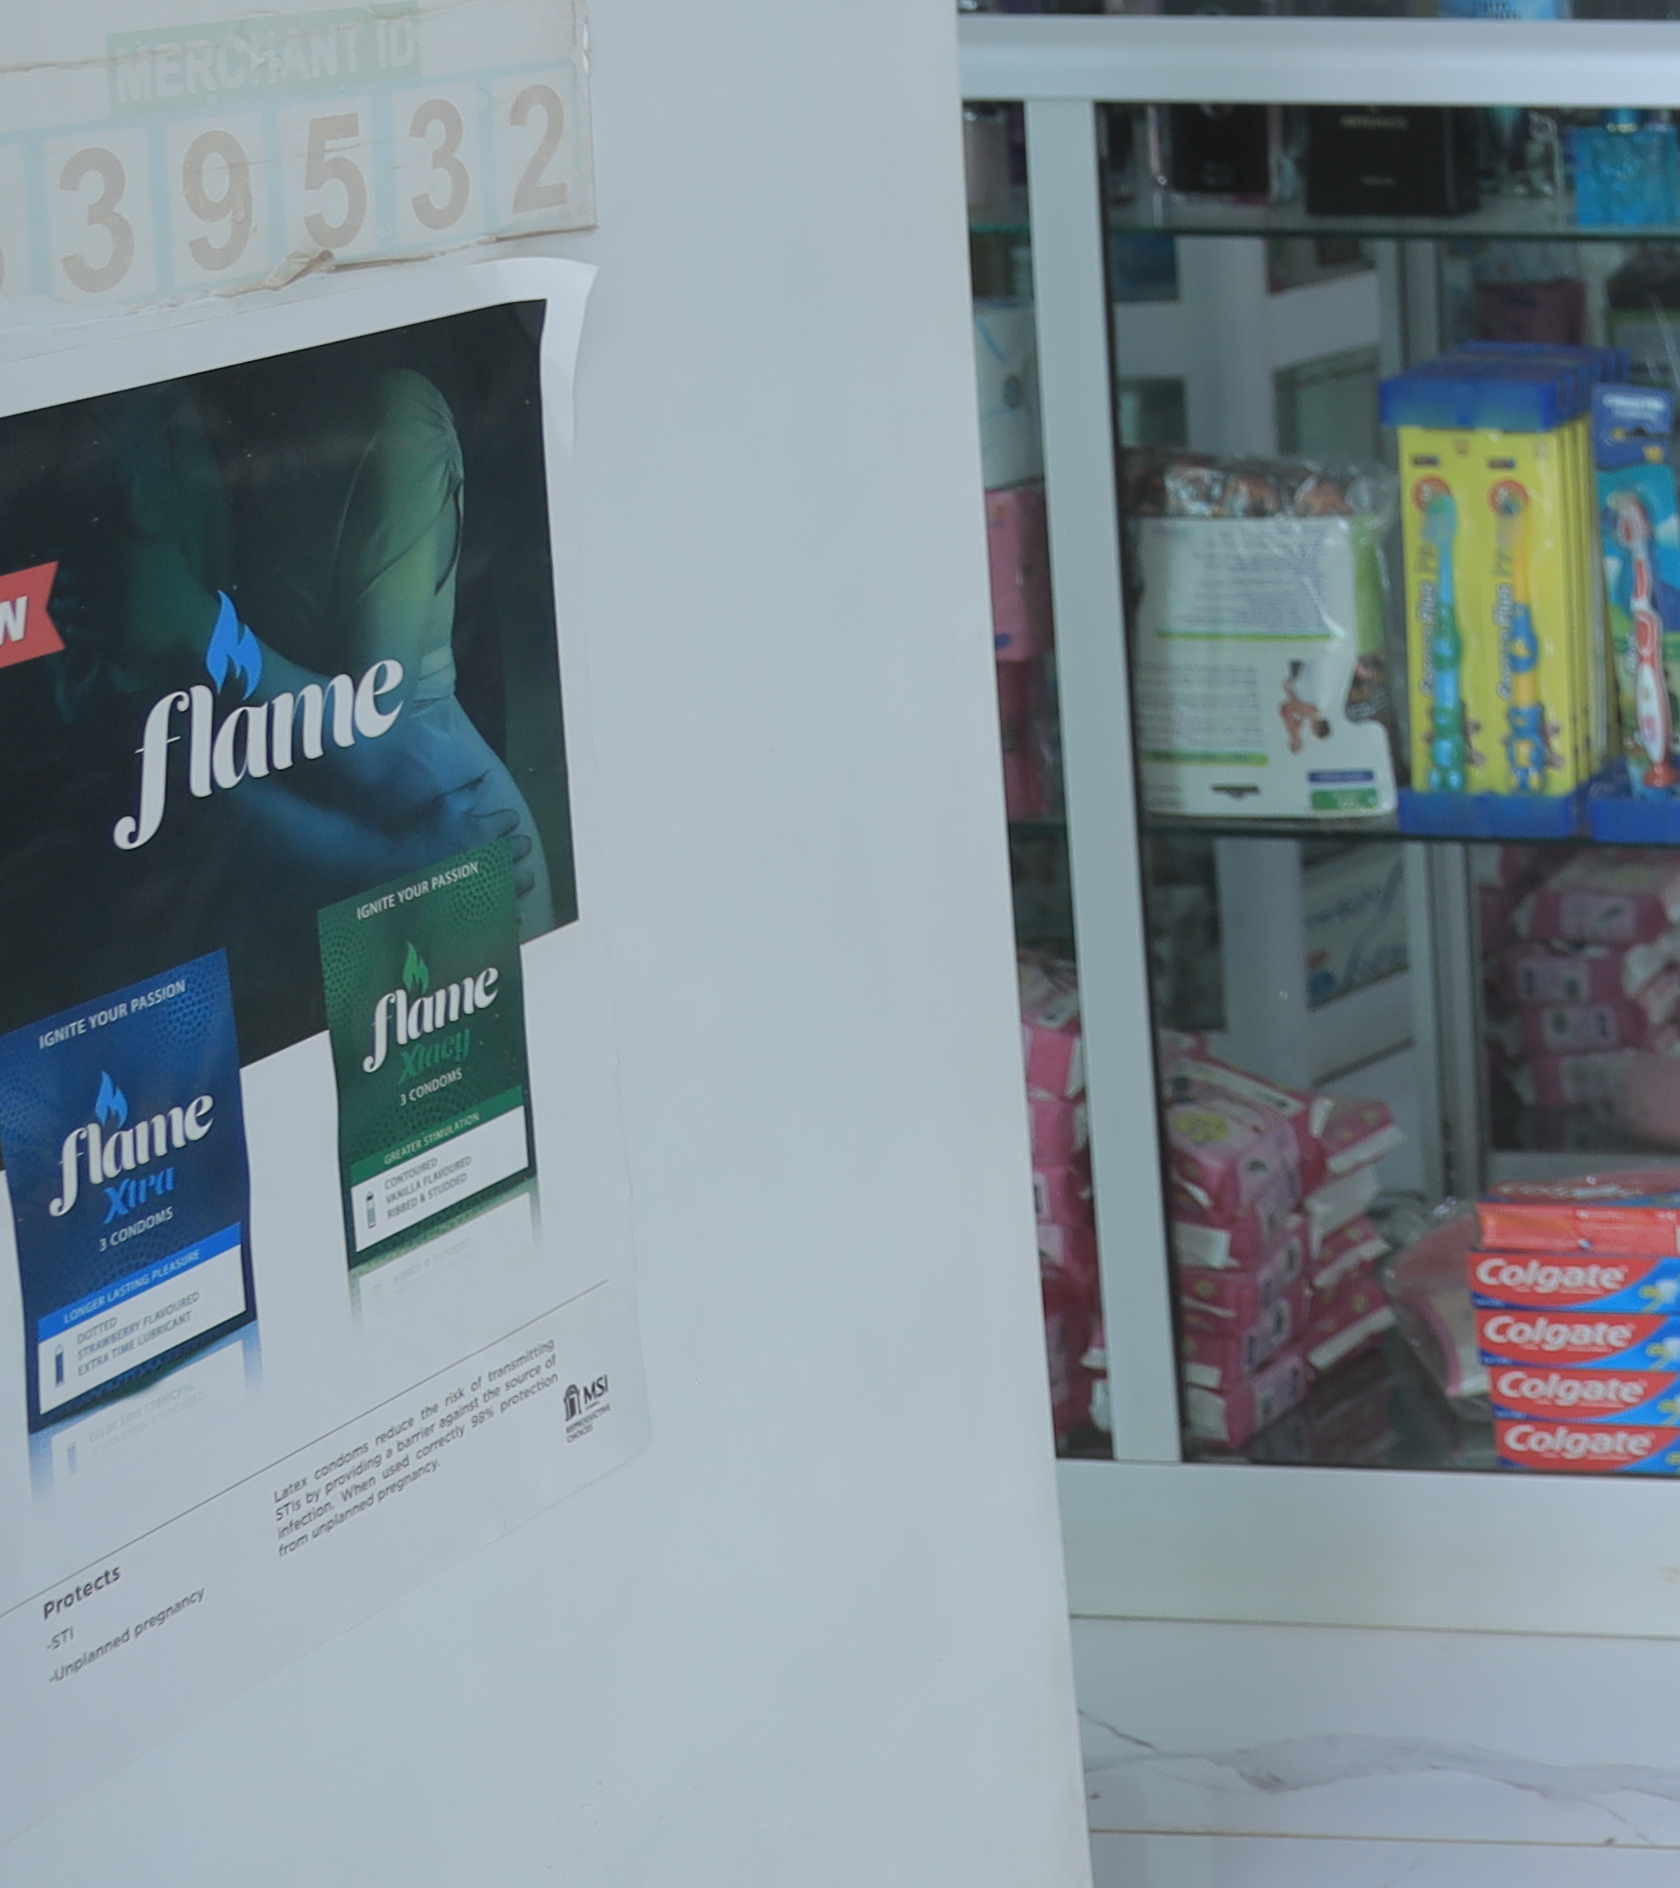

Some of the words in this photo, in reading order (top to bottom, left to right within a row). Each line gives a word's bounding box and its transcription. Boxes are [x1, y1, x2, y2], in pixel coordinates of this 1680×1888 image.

[113, 658, 404, 851] flame
[356, 892, 396, 921] IGNITE
[397, 878, 429, 904] YOUR
[431, 861, 479, 889] PASSION
[39, 1022, 87, 1050] IGNITE
[87, 1002, 128, 1029] YOUR
[130, 979, 187, 1014] PASSION
[362, 966, 500, 1074] flame
[399, 1094, 407, 1107] 3
[408, 1068, 463, 1104] CONDOMS
[49, 1094, 214, 1217] flame
[99, 1238, 107, 1252] 3
[109, 1205, 174, 1249] CONDOMS
[63, 1296, 105, 1325] LONGER
[106, 1275, 150, 1306] LASTING
[150, 1247, 202, 1288] PLEASURE
[1476, 1257, 1626, 1292] Colgate
[1484, 1316, 1635, 1351] Colgate
[583, 1374, 609, 1405] MSI
[1497, 1371, 1647, 1407] Colgate
[273, 1477, 308, 1504] Latex
[313, 1441, 369, 1481] condoms
[374, 1416, 415, 1446] reduce
[420, 1402, 440, 1422] the
[444, 1386, 466, 1407] risk
[470, 1374, 483, 1394] of
[487, 1338, 555, 1383] transmitting
[305, 1486, 322, 1505] by
[325, 1452, 382, 1498] providing
[385, 1447, 394, 1460] a
[396, 1421, 436, 1453] barrier
[438, 1396, 480, 1431] against
[484, 1383, 502, 1405] the
[504, 1364, 542, 1393] source
[544, 1353, 557, 1369] of
[1504, 1425, 1656, 1459] Colgate
[277, 1502, 336, 1541] infection.
[340, 1477, 377, 1504] When
[381, 1456, 411, 1481] used
[415, 1424, 467, 1461] correctly
[499, 1372, 559, 1416] protection
[278, 1535, 309, 1558] from
[311, 1496, 375, 1541] unplanned
[377, 1460, 441, 1504] pregnancy.
[43, 1565, 122, 1621] Protects
[133, 1587, 206, 1639] pregnancy
